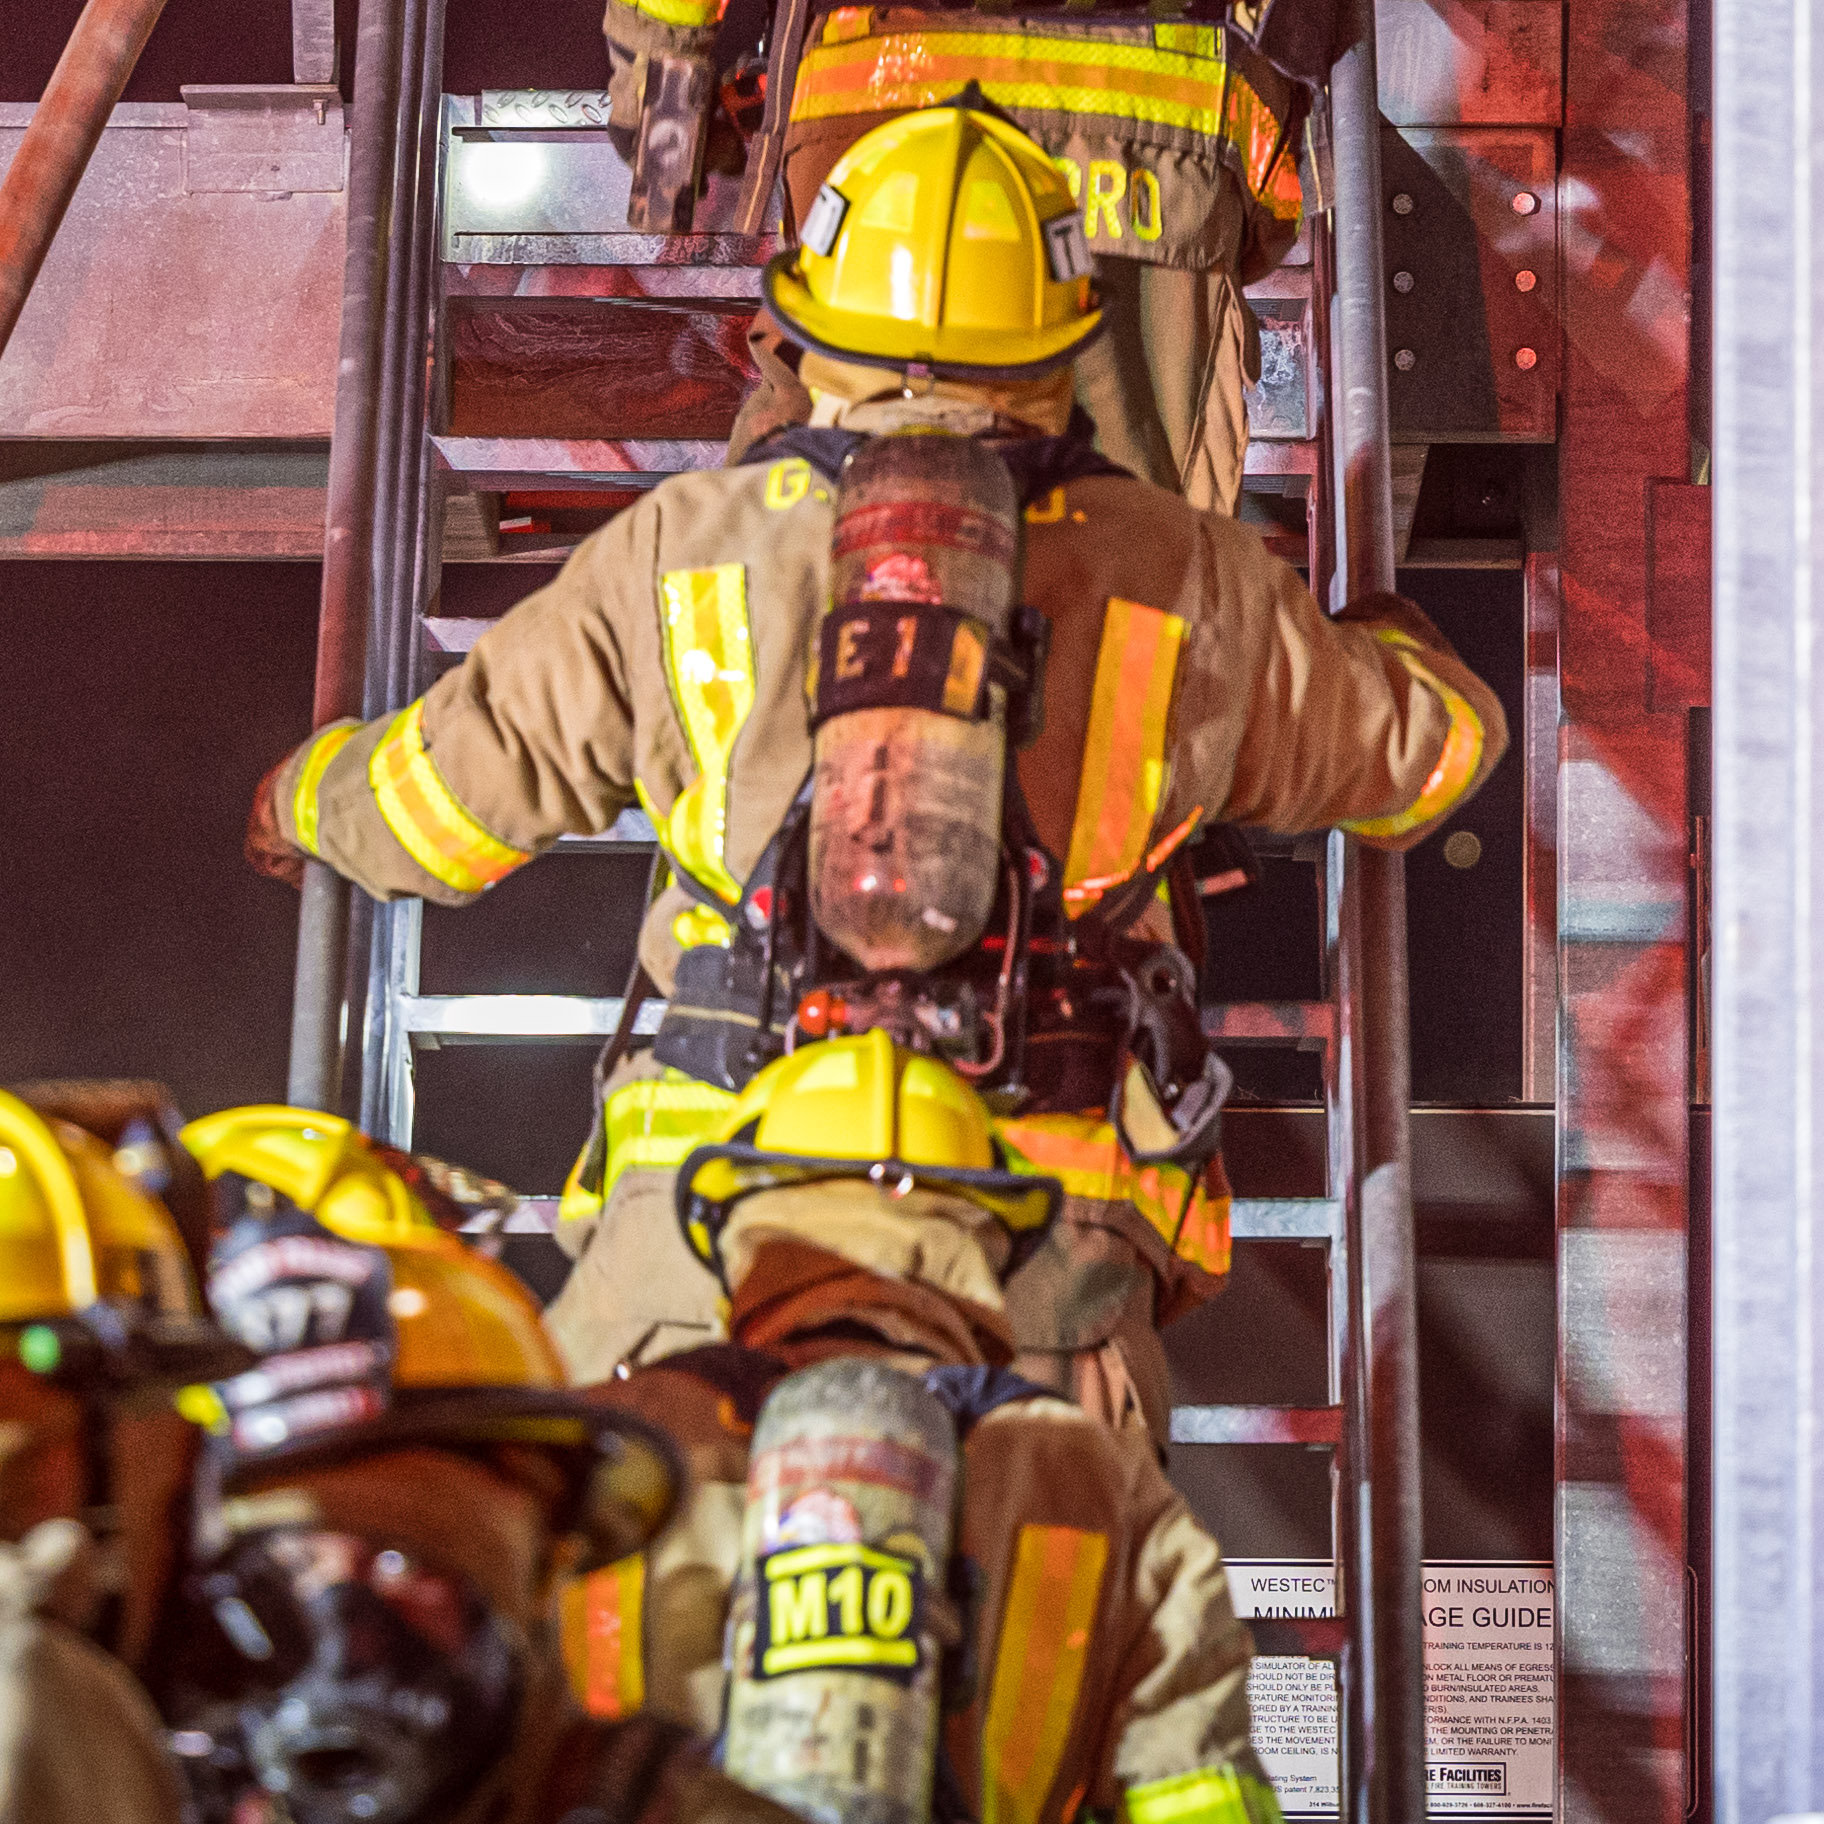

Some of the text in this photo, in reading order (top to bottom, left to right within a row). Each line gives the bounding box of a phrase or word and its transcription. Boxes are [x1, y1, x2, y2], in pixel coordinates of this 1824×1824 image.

[769, 1565, 914, 1645] M10
[1254, 1607, 1552, 1628] MINIM GE GUIDE
[1467, 1642, 1532, 1650] TEMPERATURE
[1255, 1661, 1306, 1670] SIMULATOR
[1308, 1662, 1320, 1670] OF
[1454, 1663, 1469, 1671] ALL
[1471, 1663, 1503, 1671] MEANS
[1505, 1663, 1517, 1671] OF
[1285, 1673, 1303, 1681] NOT
[1305, 1673, 1318, 1681] BE
[1436, 1674, 1465, 1682] METAL
[1467, 1674, 1497, 1682] FLOOR
[1498, 1674, 1513, 1682] OR
[1246, 1683, 1283, 1692] SHOULD
[1285, 1683, 1308, 1692] ONLY
[1310, 1684, 1323, 1692] BE
[1469, 1695, 1488, 1703] AND
[1490, 1695, 1534, 1703] TRAINEES
[1279, 1705, 1291, 1713] BY
[1316, 1716, 1329, 1724] BE
[1264, 1726, 1277, 1734] TO
[1279, 1726, 1296, 1734] THE
[1297, 1726, 1337, 1734] WESTEC
[1431, 1726, 1448, 1735] THE
[1450, 1726, 1498, 1735] MOUNTING
[1499, 1727, 1514, 1735] OR
[1266, 1736, 1283, 1744] THE
[1285, 1736, 1336, 1745] MOVEMENT
[1440, 1737, 1455, 1745] OR
[1456, 1737, 1474, 1745] THE
[1475, 1737, 1513, 1745] FAILURE
[1514, 1737, 1527, 1745] TO
[1320, 1747, 1330, 1755] IS
[1430, 1748, 1466, 1756] LIMITED
[1289, 1774, 1318, 1783] System
[1439, 1767, 1502, 1782] FACILITIES
[1284, 1786, 1307, 1794] patent
[1430, 1782, 1502, 1790] FIRE TRAINING TOWERS
